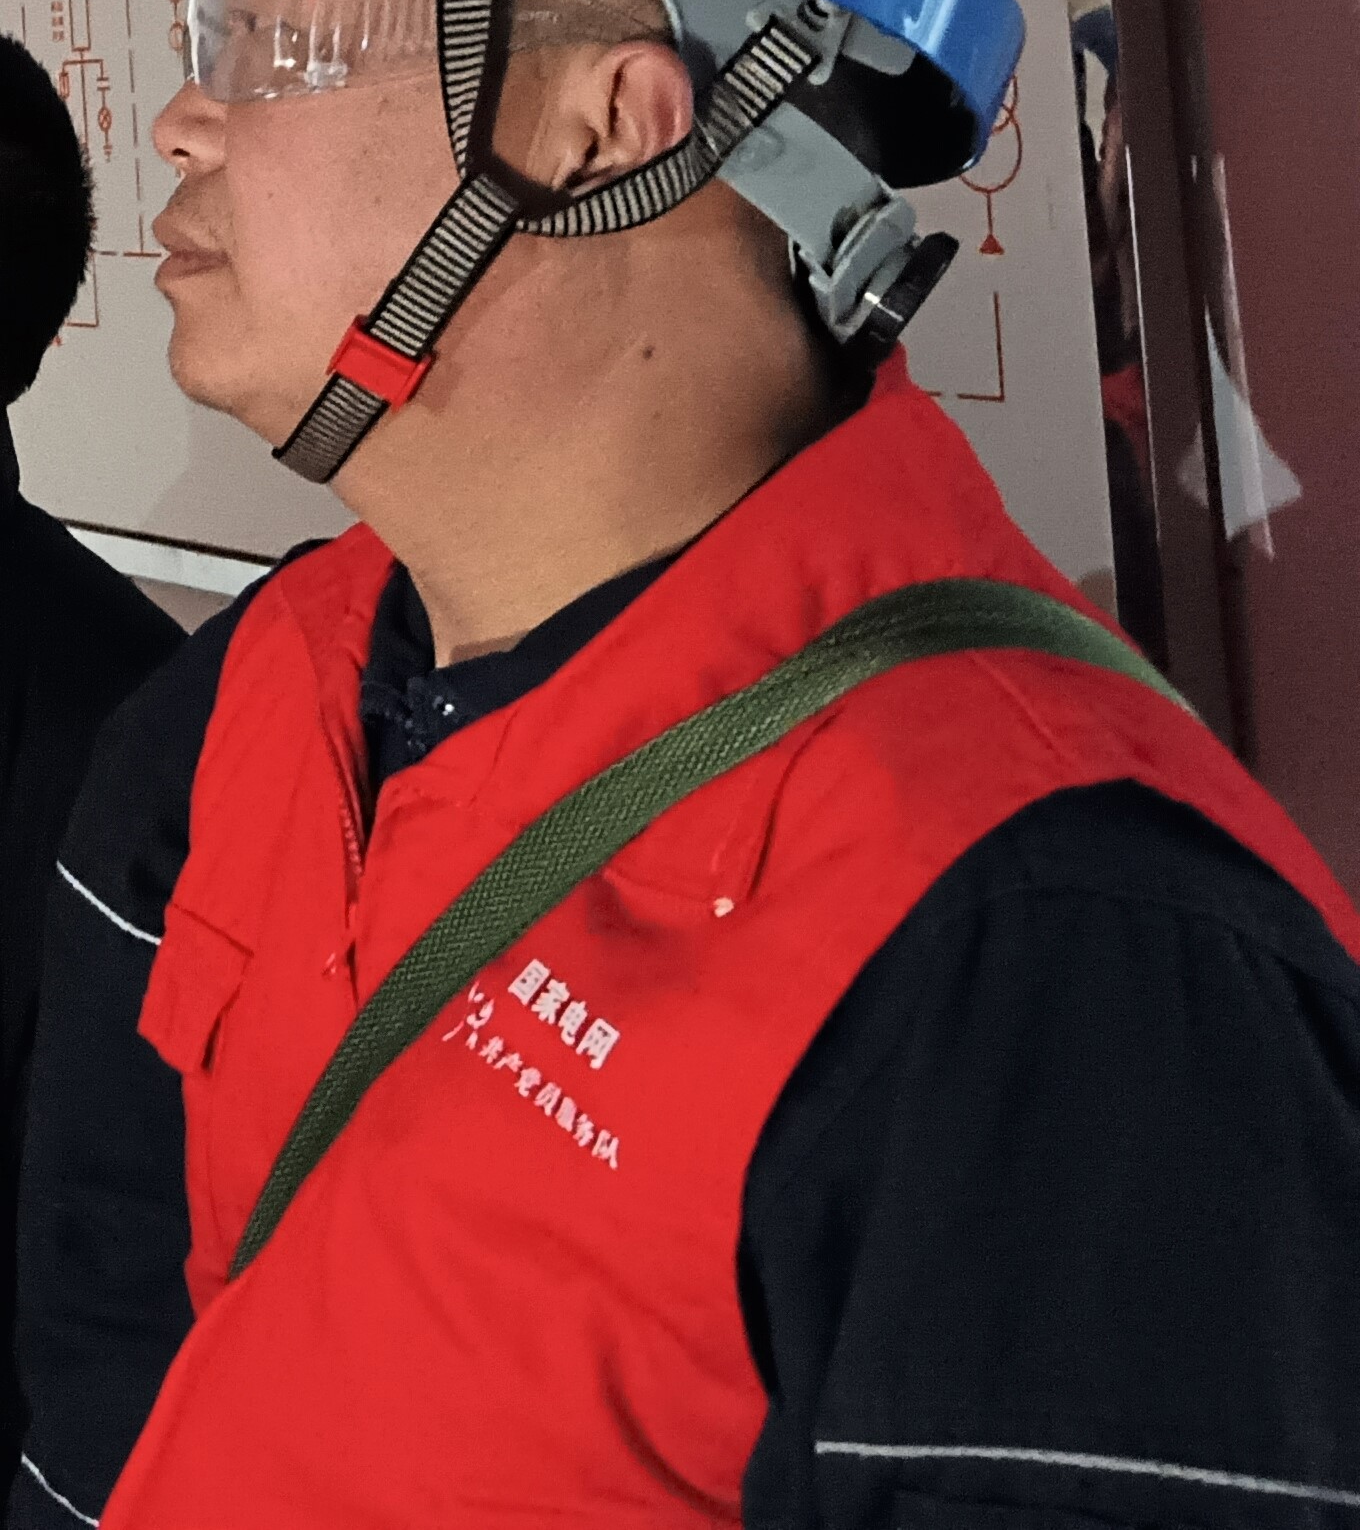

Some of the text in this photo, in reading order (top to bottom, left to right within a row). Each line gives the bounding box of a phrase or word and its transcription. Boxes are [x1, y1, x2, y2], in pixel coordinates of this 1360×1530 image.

[507, 958, 621, 1071] 国家电网
[478, 1035, 621, 1171] 共产党员服务队
